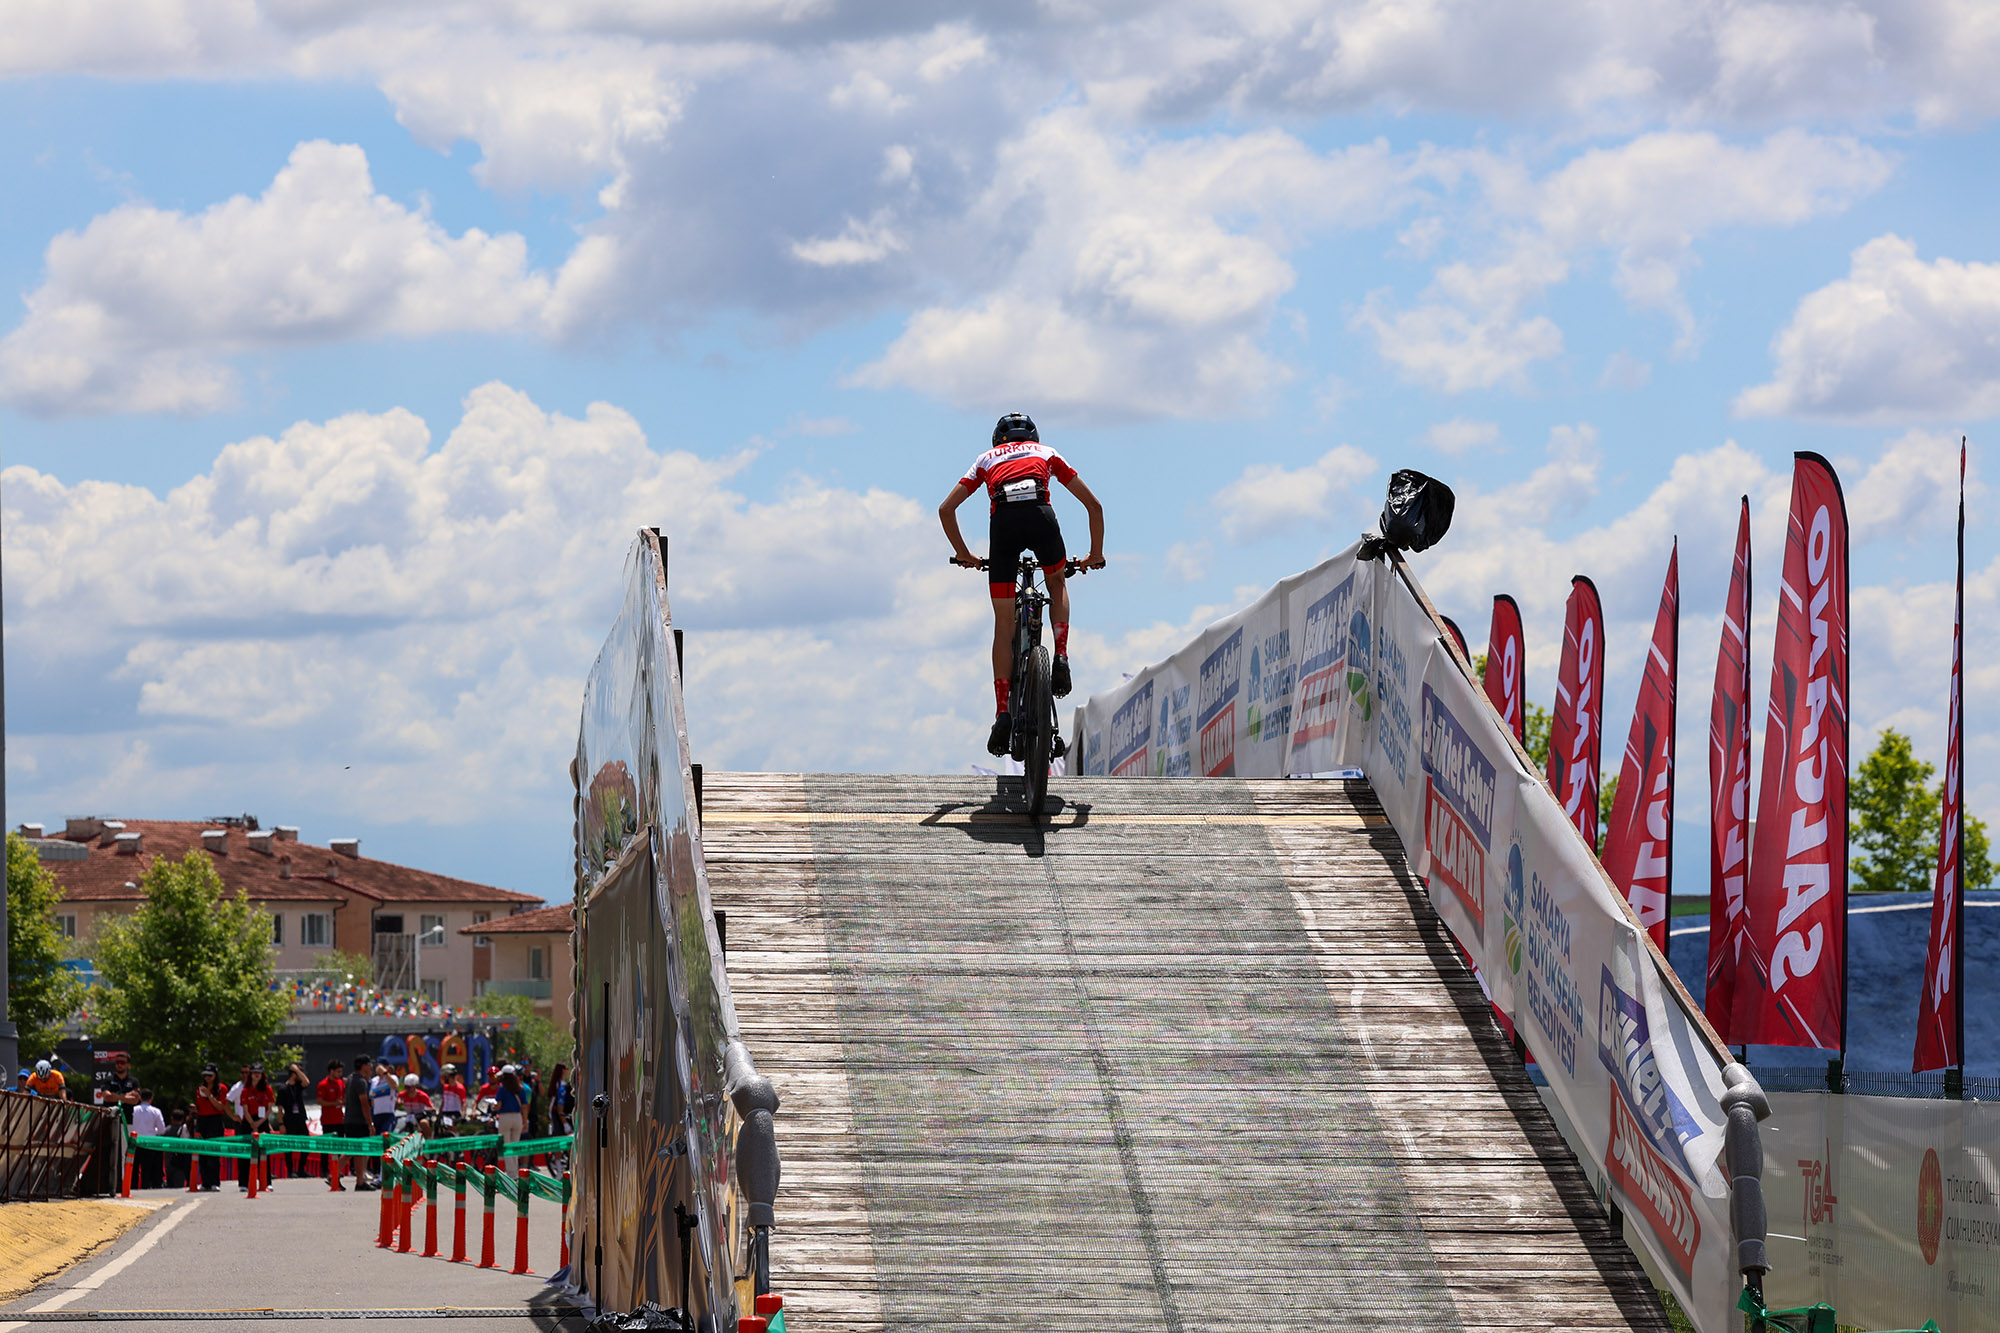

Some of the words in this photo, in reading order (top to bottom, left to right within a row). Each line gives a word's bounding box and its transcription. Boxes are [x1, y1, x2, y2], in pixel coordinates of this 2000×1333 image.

[1380, 625, 1407, 693] SAKARYA
[1430, 798, 1482, 912] AKARYA
[1530, 871, 1570, 964] SAKARYA
[1527, 968, 1576, 1080] BELEDİYESİ
[1528, 918, 1583, 1038] BÜYÜKŞEHİR
